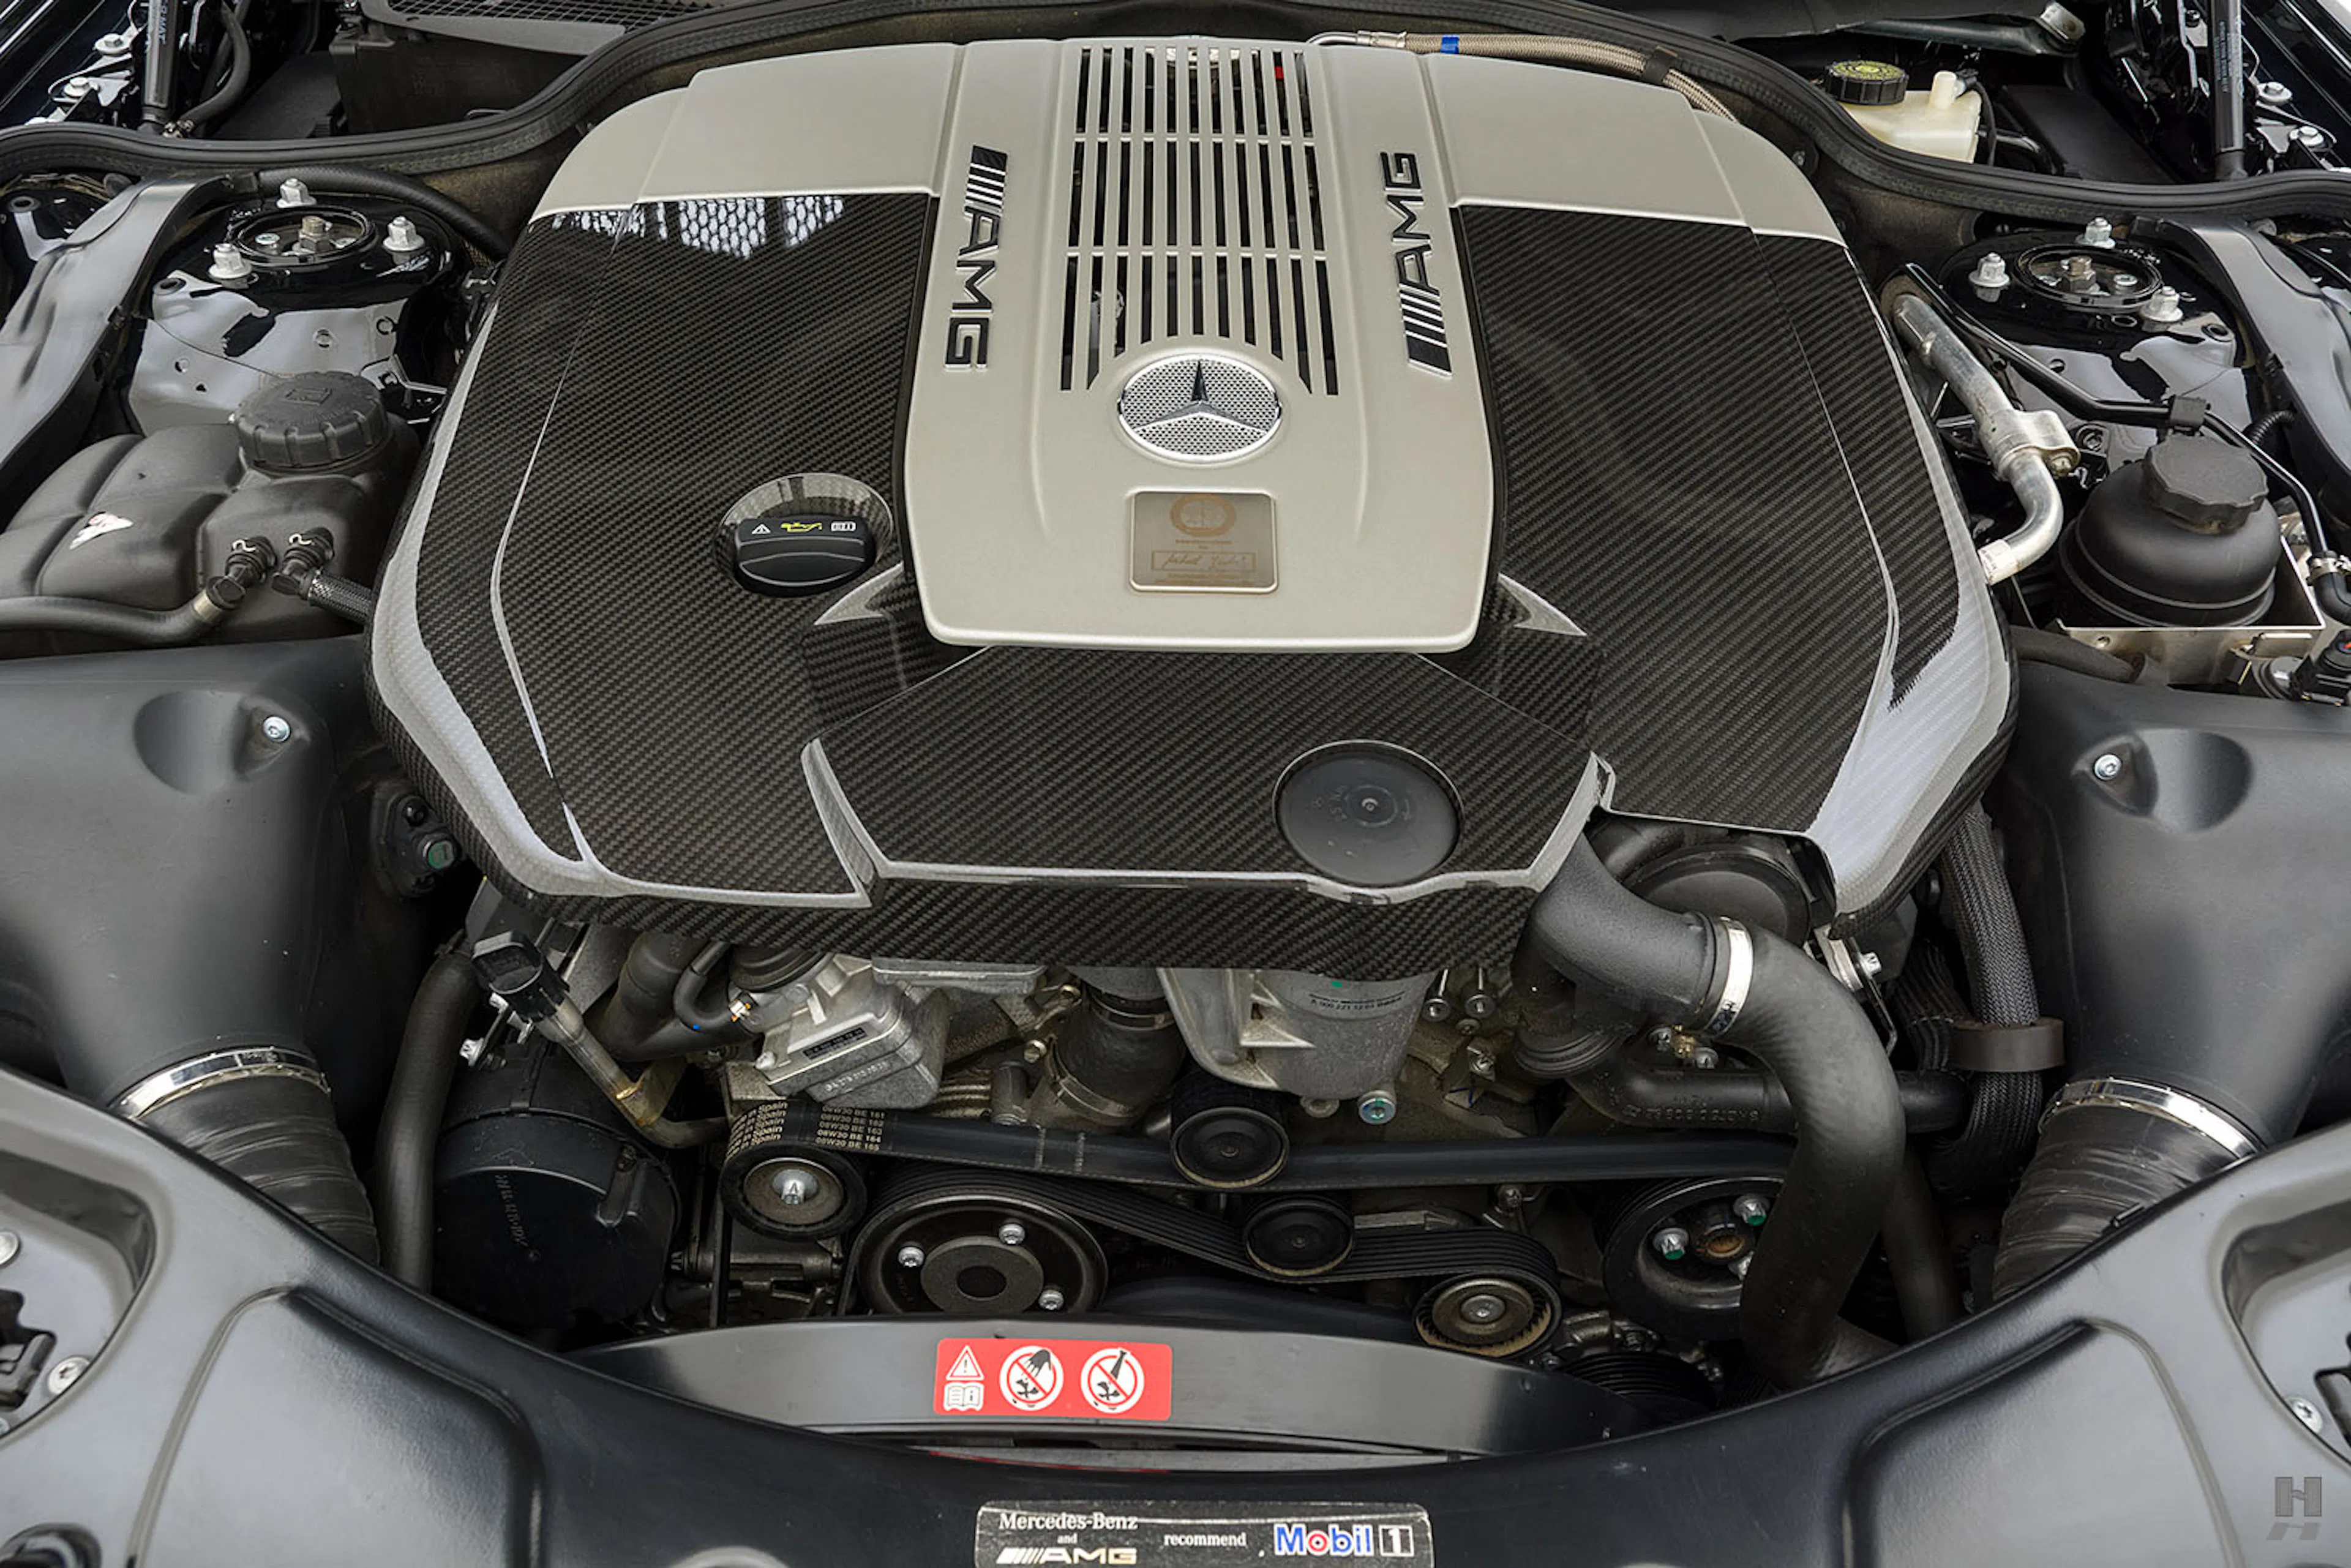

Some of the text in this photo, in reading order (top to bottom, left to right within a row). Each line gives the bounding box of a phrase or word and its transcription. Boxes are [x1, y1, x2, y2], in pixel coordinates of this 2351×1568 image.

[1380, 152, 1441, 297] AMG
[945, 204, 1000, 368] AMG
[999, 1512, 1138, 1530] Mercedes-Benz
[1057, 1533, 1078, 1544] and
[1164, 1532, 1247, 1547] recommend
[1274, 1523, 1373, 1556] Mobil
